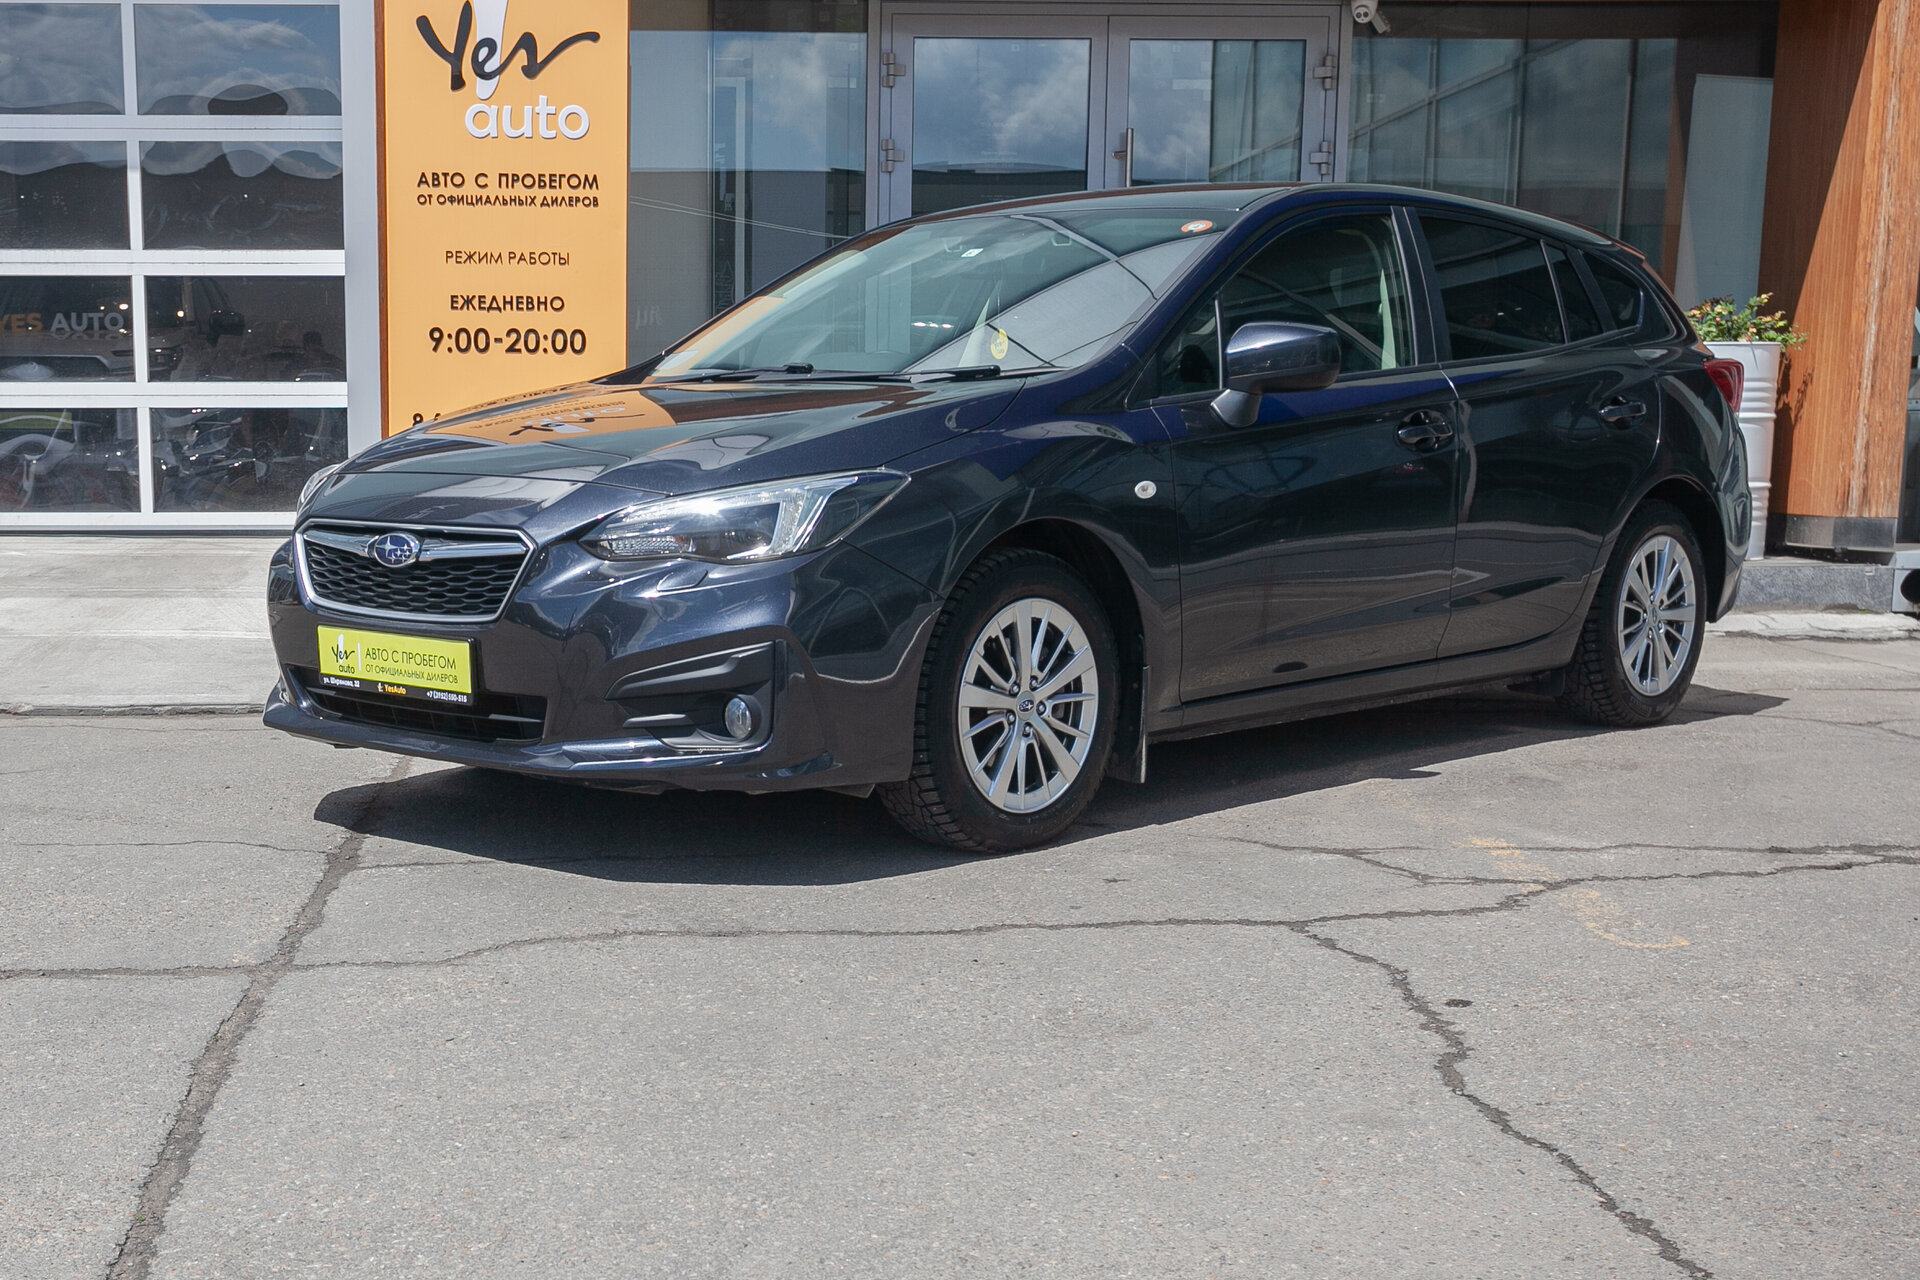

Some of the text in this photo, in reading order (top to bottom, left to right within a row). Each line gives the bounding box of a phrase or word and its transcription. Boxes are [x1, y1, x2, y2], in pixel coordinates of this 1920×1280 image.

[416, 0, 600, 92] Yes
[465, 95, 590, 140] auto
[417, 171, 599, 190] АВТО С ПРОБЕГОМ
[416, 194, 599, 208] ОТ ОФИЦИАЛЬНЫХ ДИЛЕРОВ
[445, 250, 570, 266] РЕЖИМ РАБОТЫ
[450, 294, 565, 313] ЕЖЕДНЕВНО
[50, 312, 124, 332] AUTO
[429, 326, 587, 354] 9:00-20:00
[365, 647, 457, 670] АВТО С ПРОБЕГОМ
[338, 663, 356, 675] auto
[365, 663, 459, 684] ОТ ОФИЦИАЛЬНЫХ ДИЛЕРОВ
